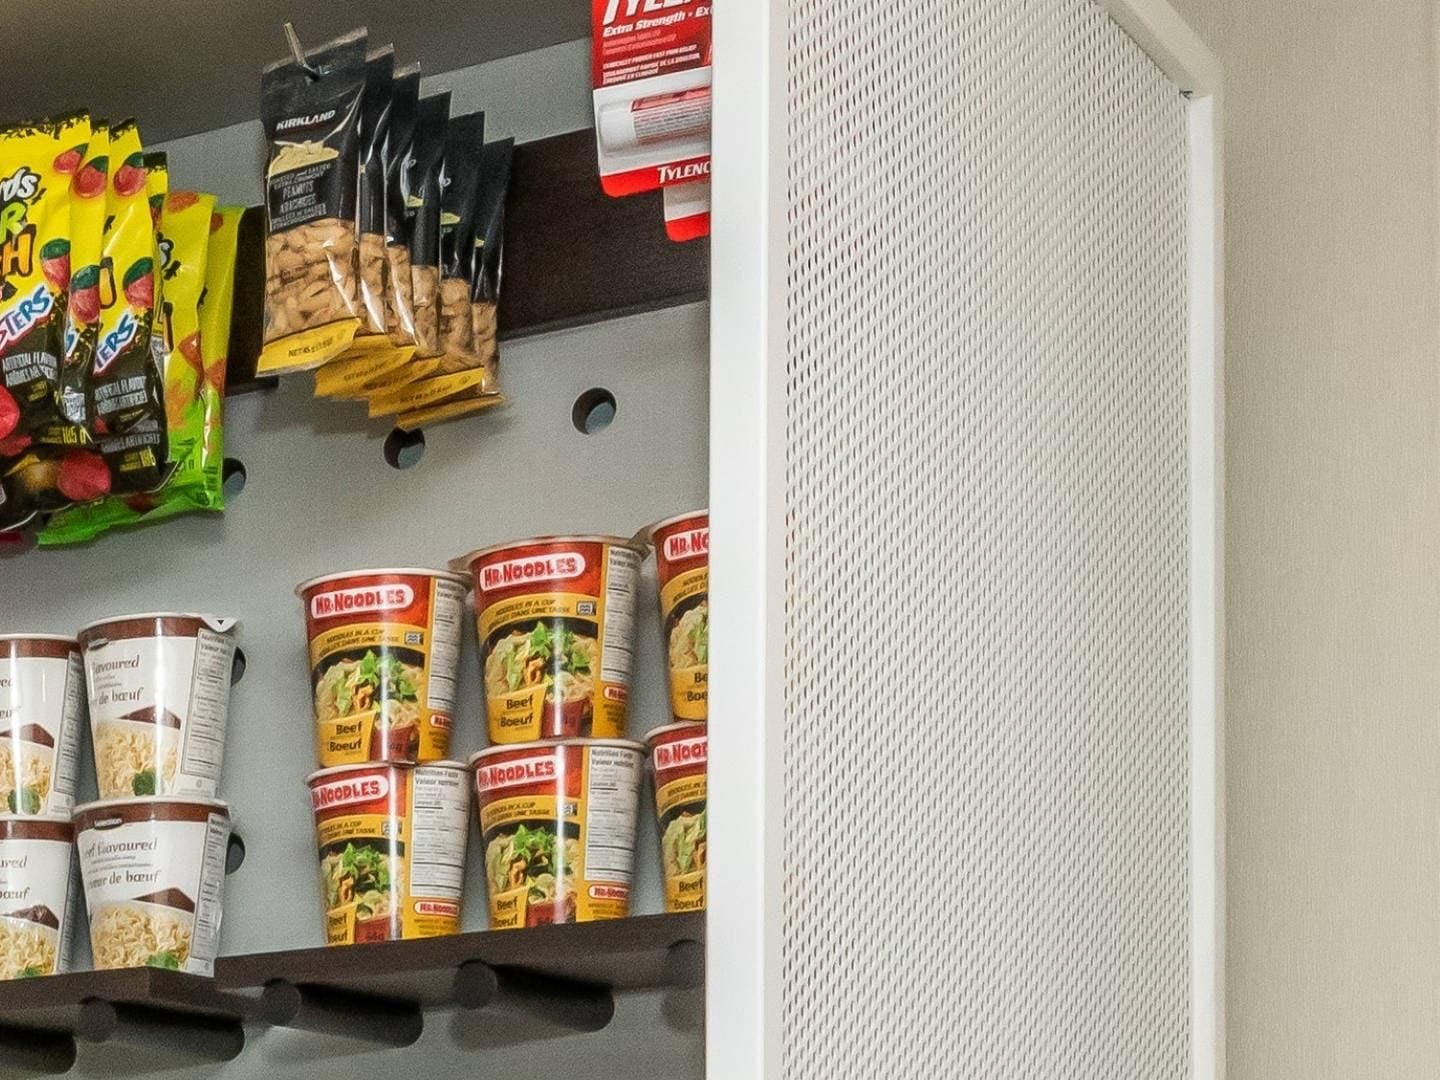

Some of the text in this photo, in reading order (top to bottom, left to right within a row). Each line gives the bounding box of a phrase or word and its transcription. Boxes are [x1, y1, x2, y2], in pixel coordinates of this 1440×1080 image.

[603, 6, 712, 38] Extra Strength Ex
[271, 109, 336, 131] KIRKLAND
[503, 557, 578, 583] NOODLES
[506, 695, 535, 711] Beef
[499, 711, 535, 729] Boeuf
[335, 721, 362, 737] Beef
[329, 739, 362, 753] Boeuf
[490, 760, 555, 785] NOODLES
[678, 879, 704, 893] Beef
[496, 899, 518, 911] Beef
